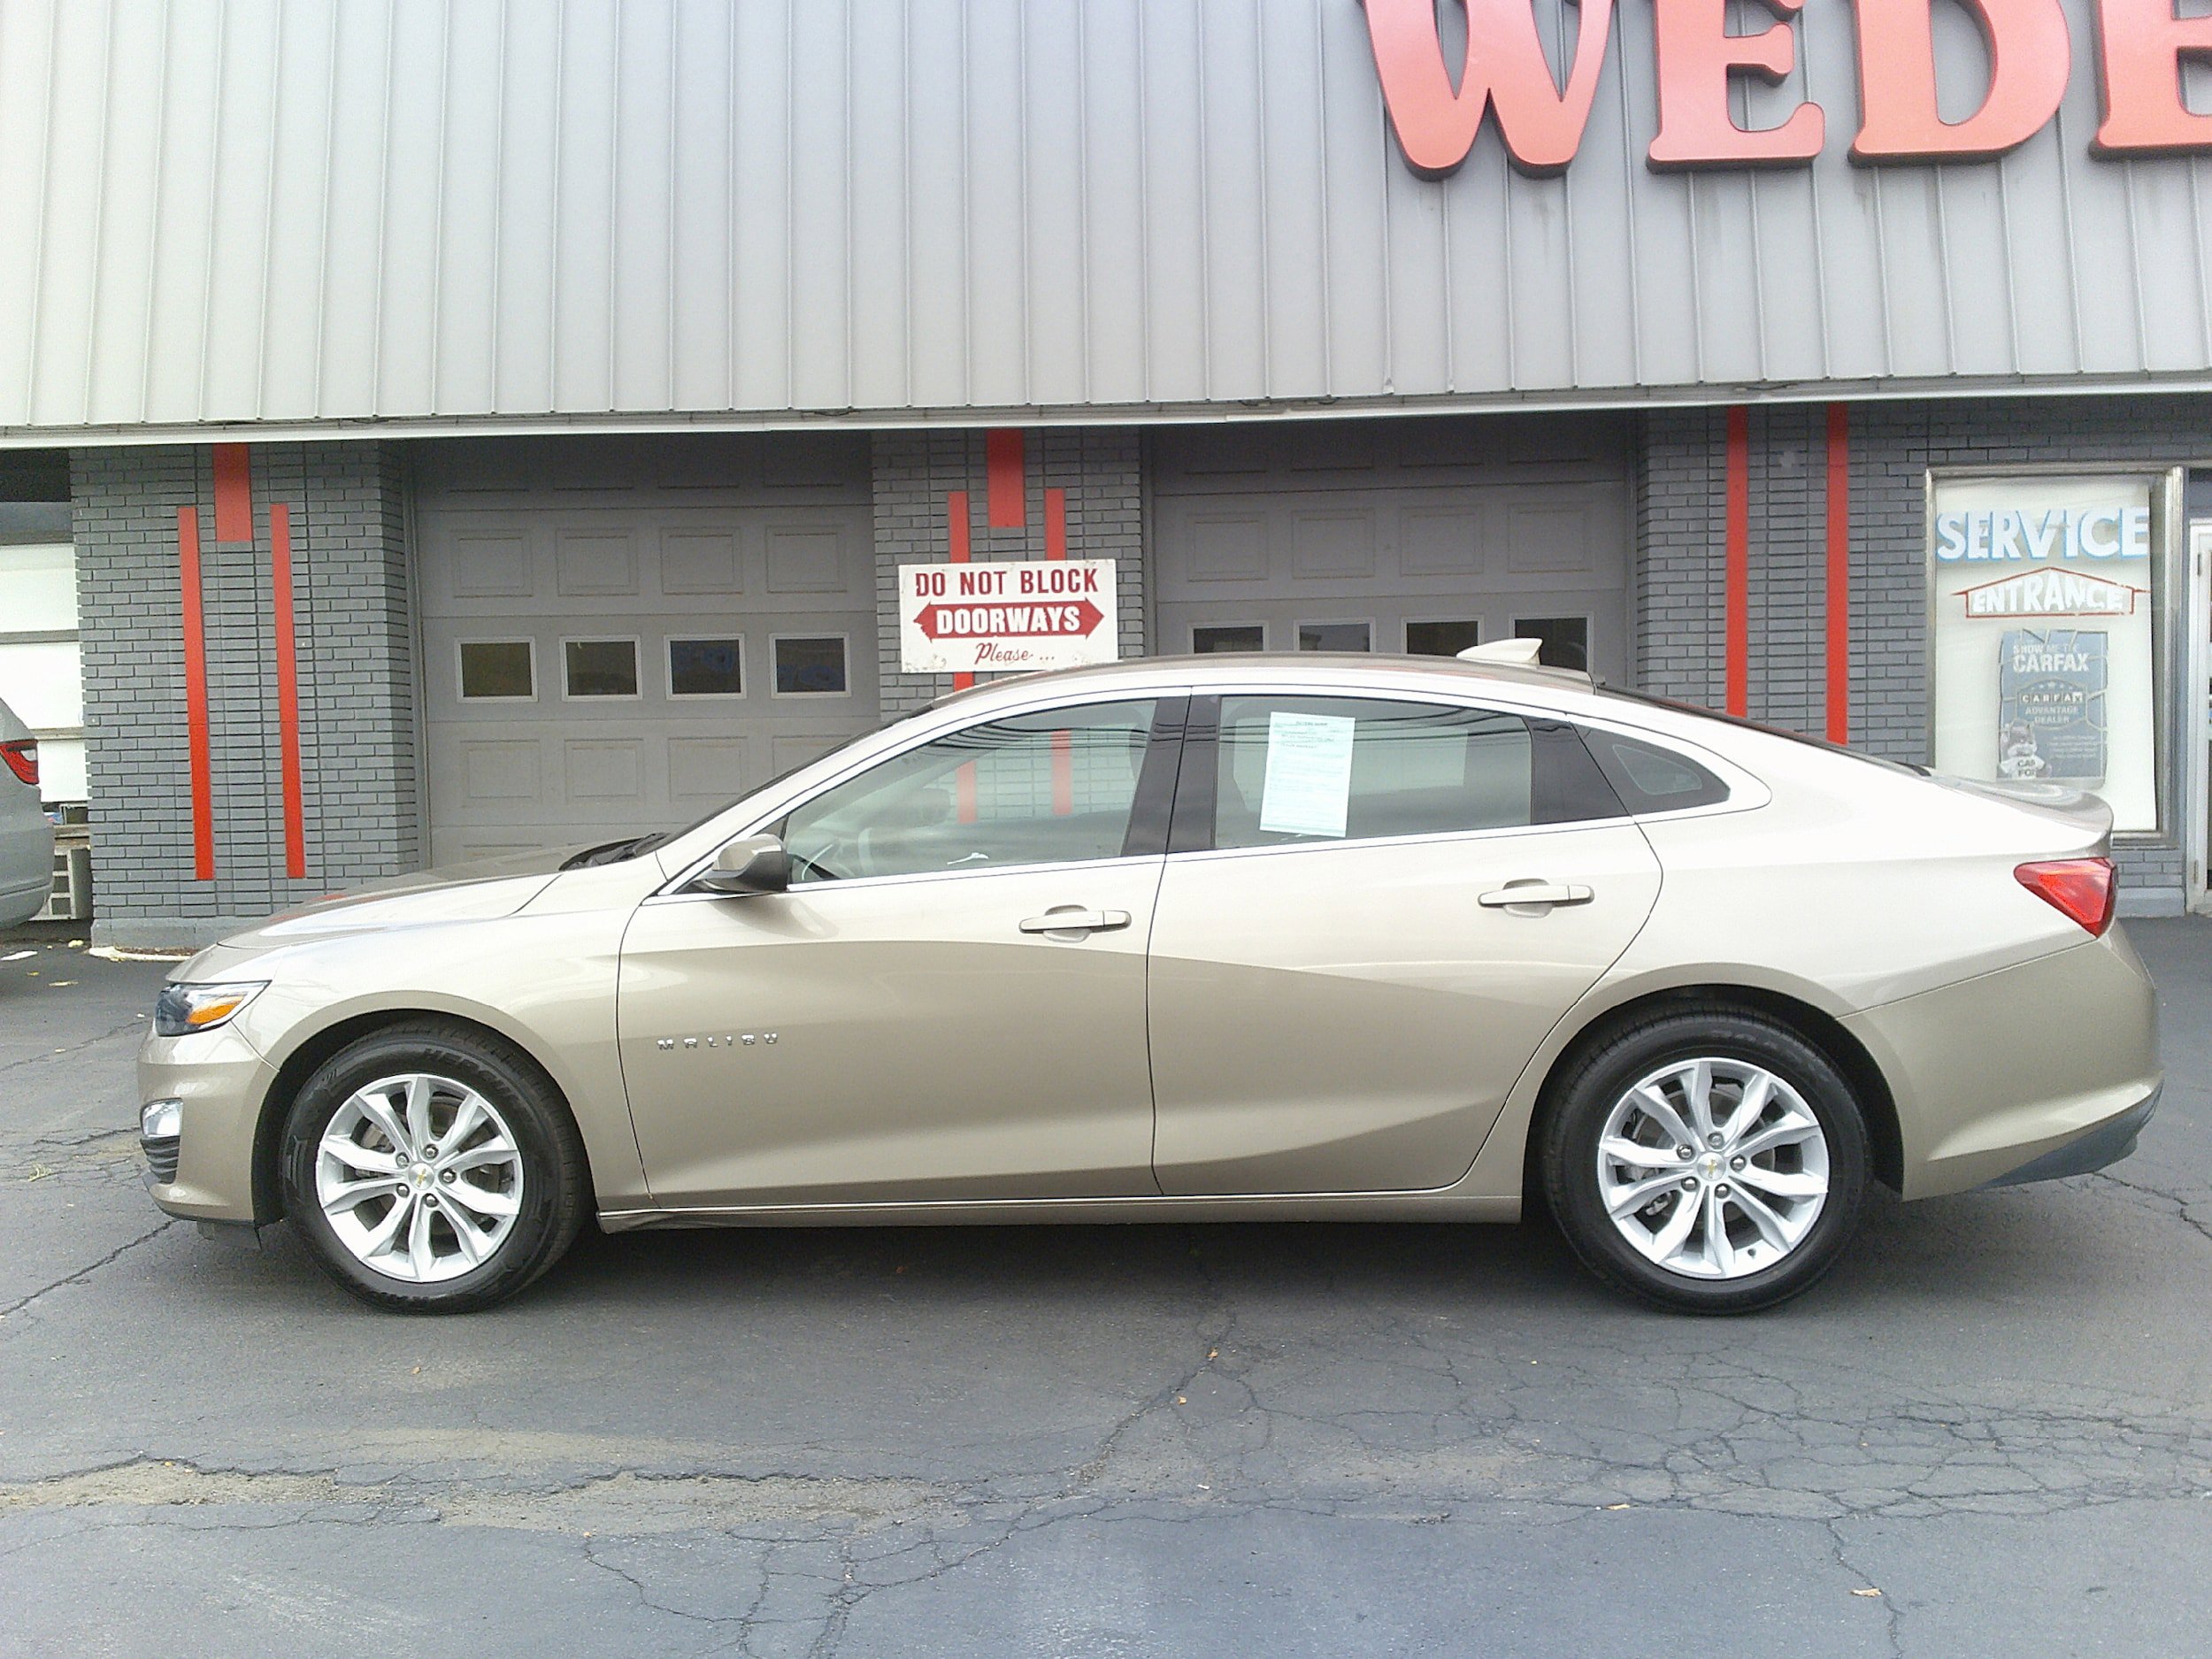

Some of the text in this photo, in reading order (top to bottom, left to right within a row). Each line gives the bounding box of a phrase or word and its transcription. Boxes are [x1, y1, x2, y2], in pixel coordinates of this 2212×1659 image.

[1936, 507, 2150, 561] SERVICE
[916, 568, 1098, 597] DO NOT BLOCK
[1972, 573, 2124, 612] ENTRANCE
[936, 605, 1080, 634] DOORWAYS
[2013, 653, 2089, 672] CARFAX
[2022, 692, 2084, 704] CARFAX
[657, 1033, 777, 1050] MALIBU
